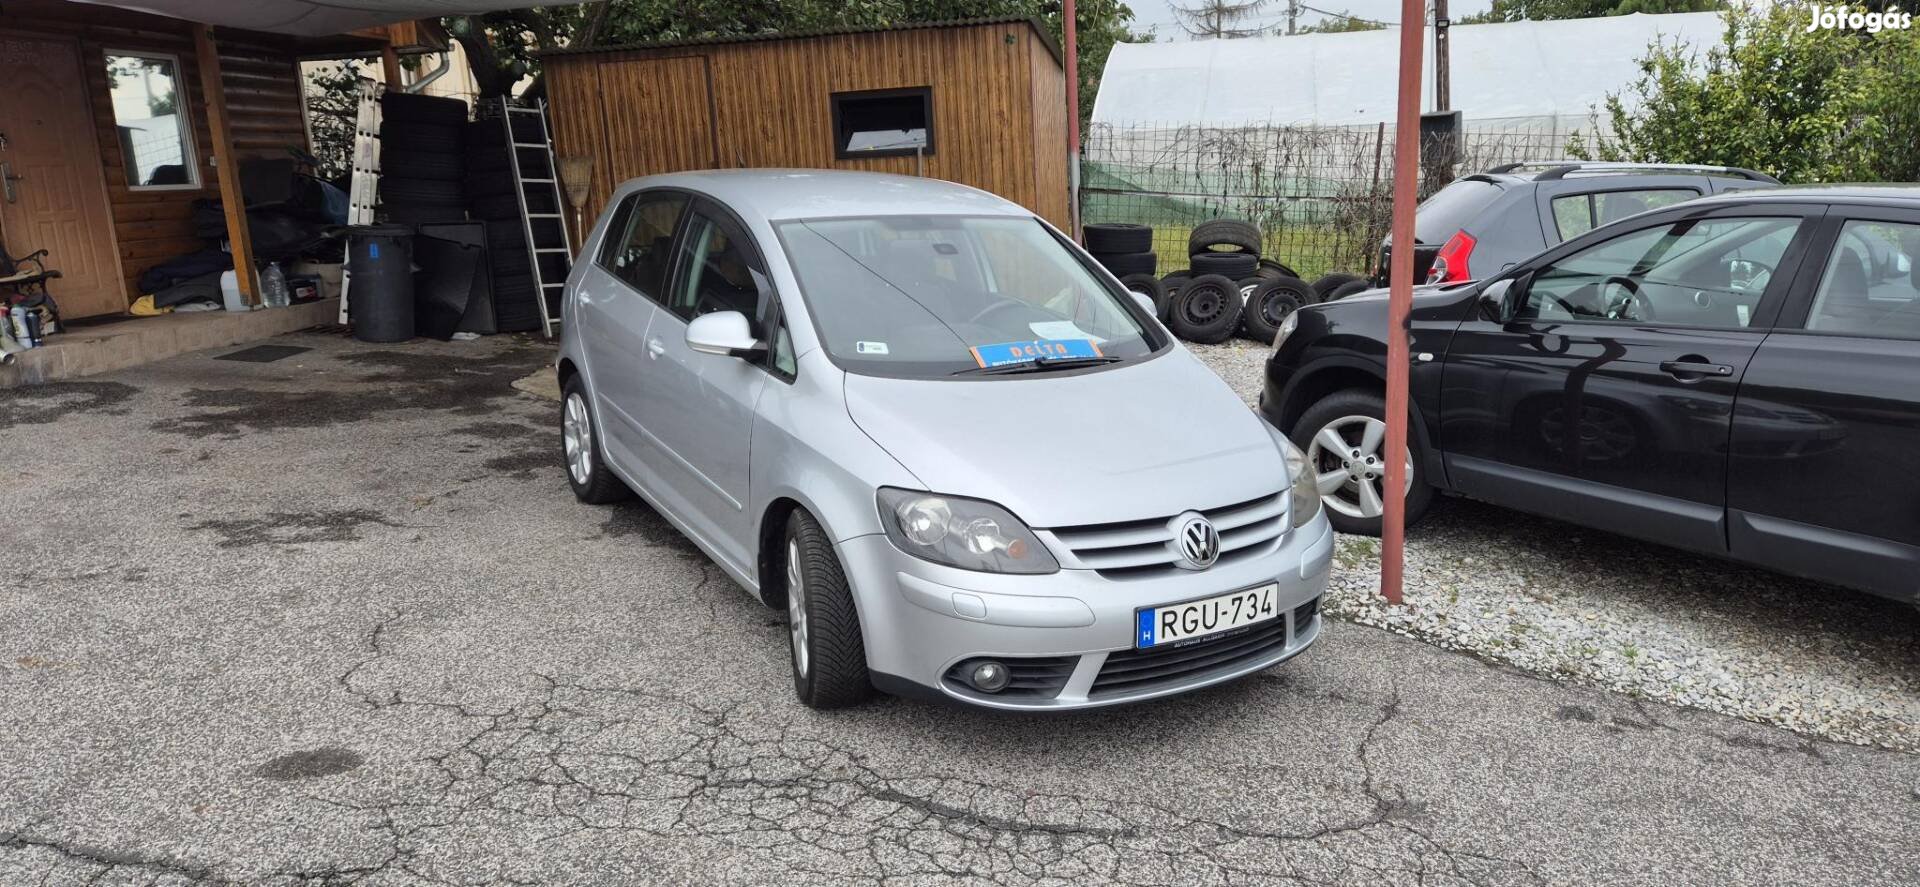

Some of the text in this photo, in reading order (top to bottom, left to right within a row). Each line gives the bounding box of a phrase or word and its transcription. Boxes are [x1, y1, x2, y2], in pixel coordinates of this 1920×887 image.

[1009, 343, 1068, 358] DELTA
[1161, 590, 1272, 639] RGU-734
[1143, 631, 1151, 641] H
